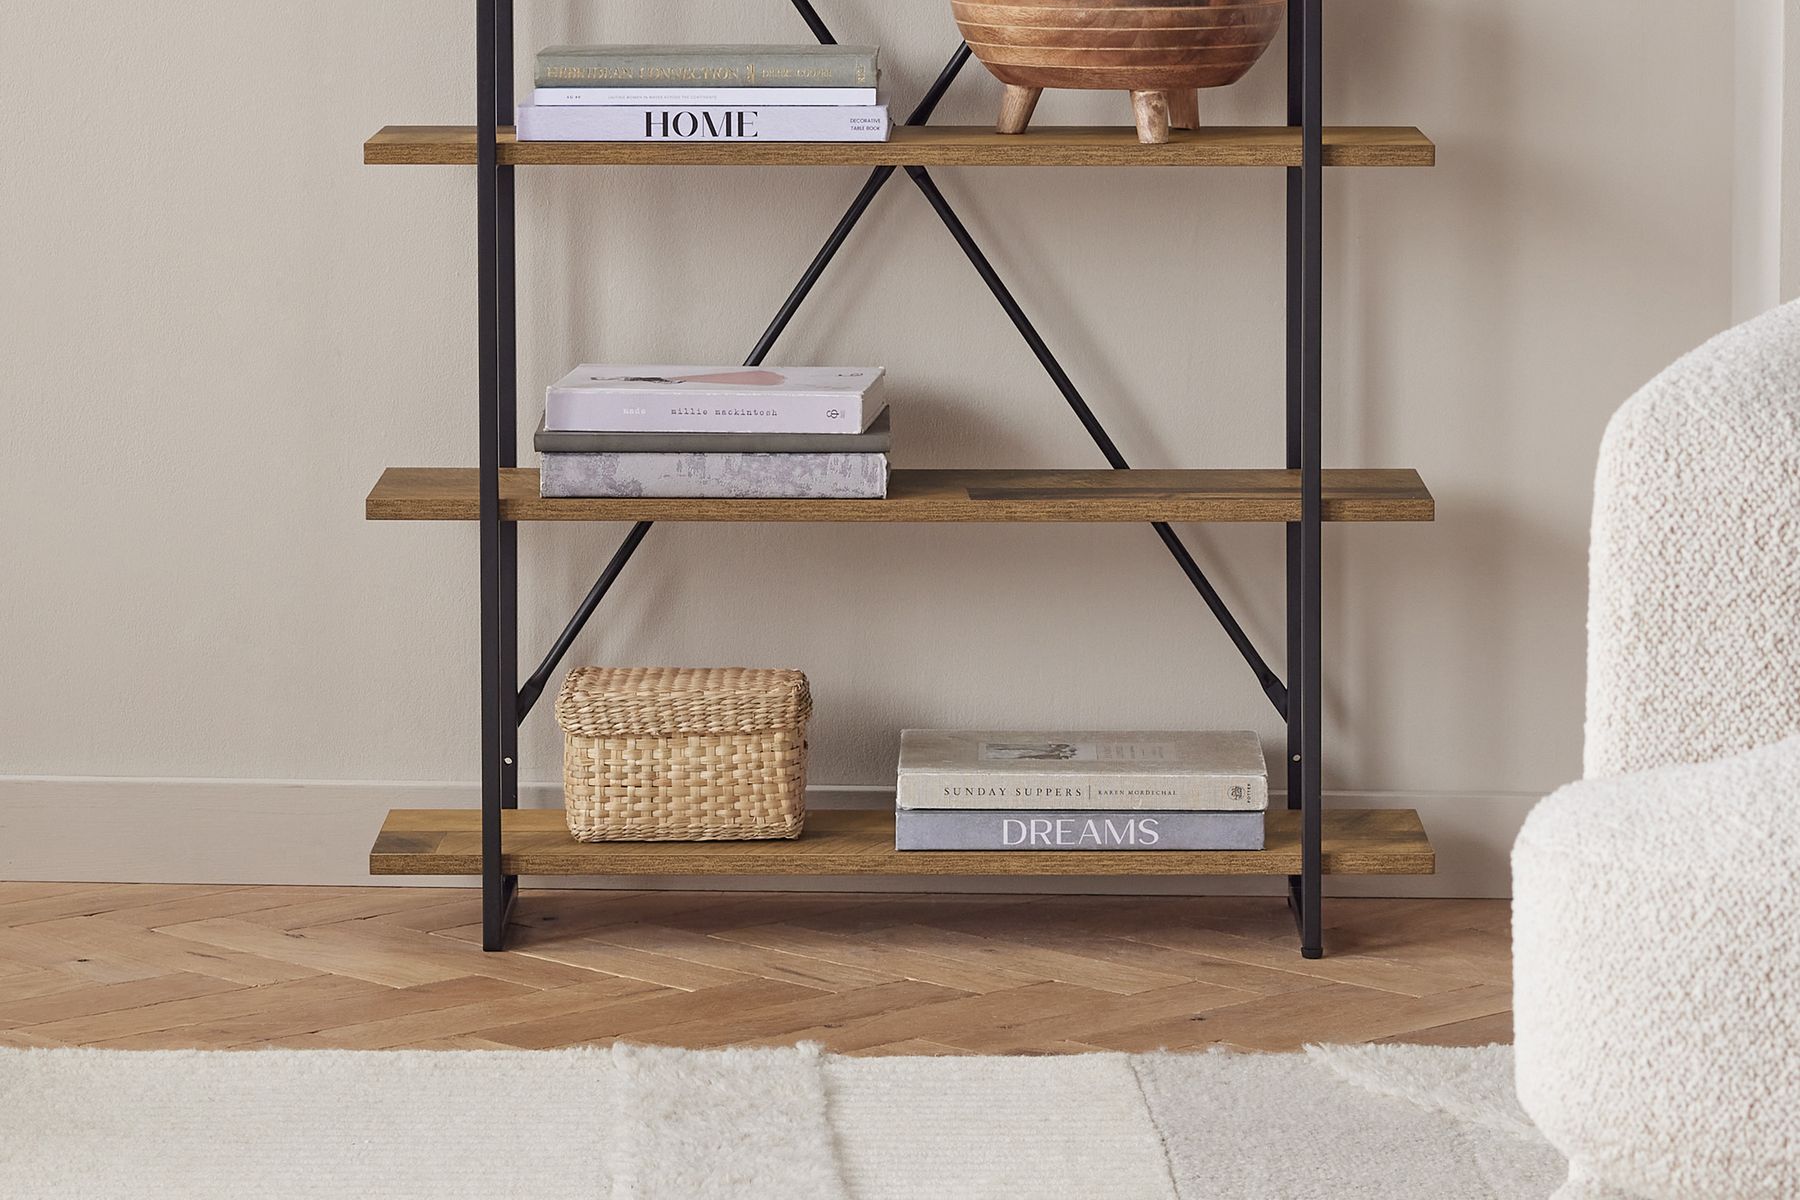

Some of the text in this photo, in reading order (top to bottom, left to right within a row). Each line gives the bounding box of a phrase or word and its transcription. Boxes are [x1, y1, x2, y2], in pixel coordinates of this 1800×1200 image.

[639, 66, 739, 80] CONNECTION
[644, 110, 759, 138] HOME
[671, 407, 778, 417] millie mackintosh
[944, 787, 1082, 797] SUNDAY SUPPERS
[1002, 818, 1160, 846] DREAMS
